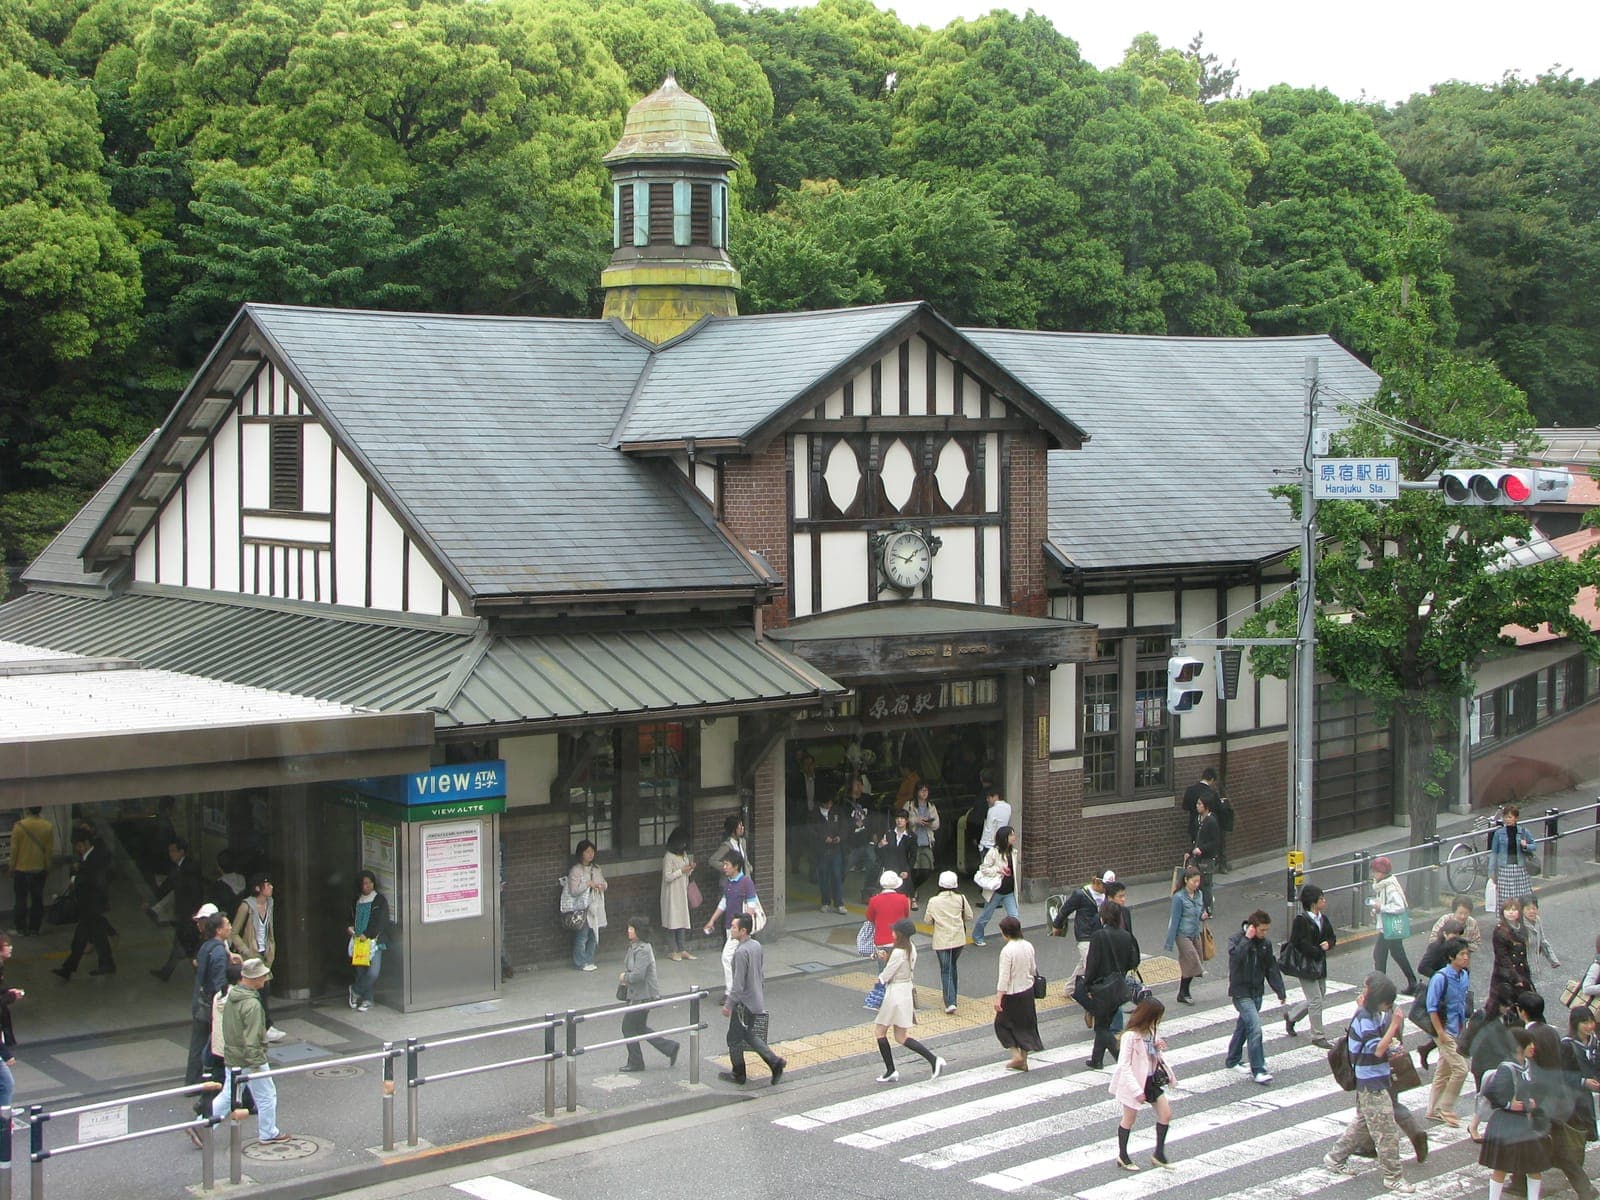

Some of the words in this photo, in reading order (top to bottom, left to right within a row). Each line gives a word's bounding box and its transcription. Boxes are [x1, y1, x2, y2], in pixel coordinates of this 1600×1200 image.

[1320, 464, 1391, 481] 原宿駅前
[1325, 484, 1362, 494] Harajuku
[1369, 484, 1386, 493] Sta.
[869, 693, 935, 719] 原宿駅
[475, 770, 496, 782] ATM
[474, 781, 498, 790] コーナー
[432, 807, 456, 815] VIEW
[457, 804, 484, 813] ALTTE
